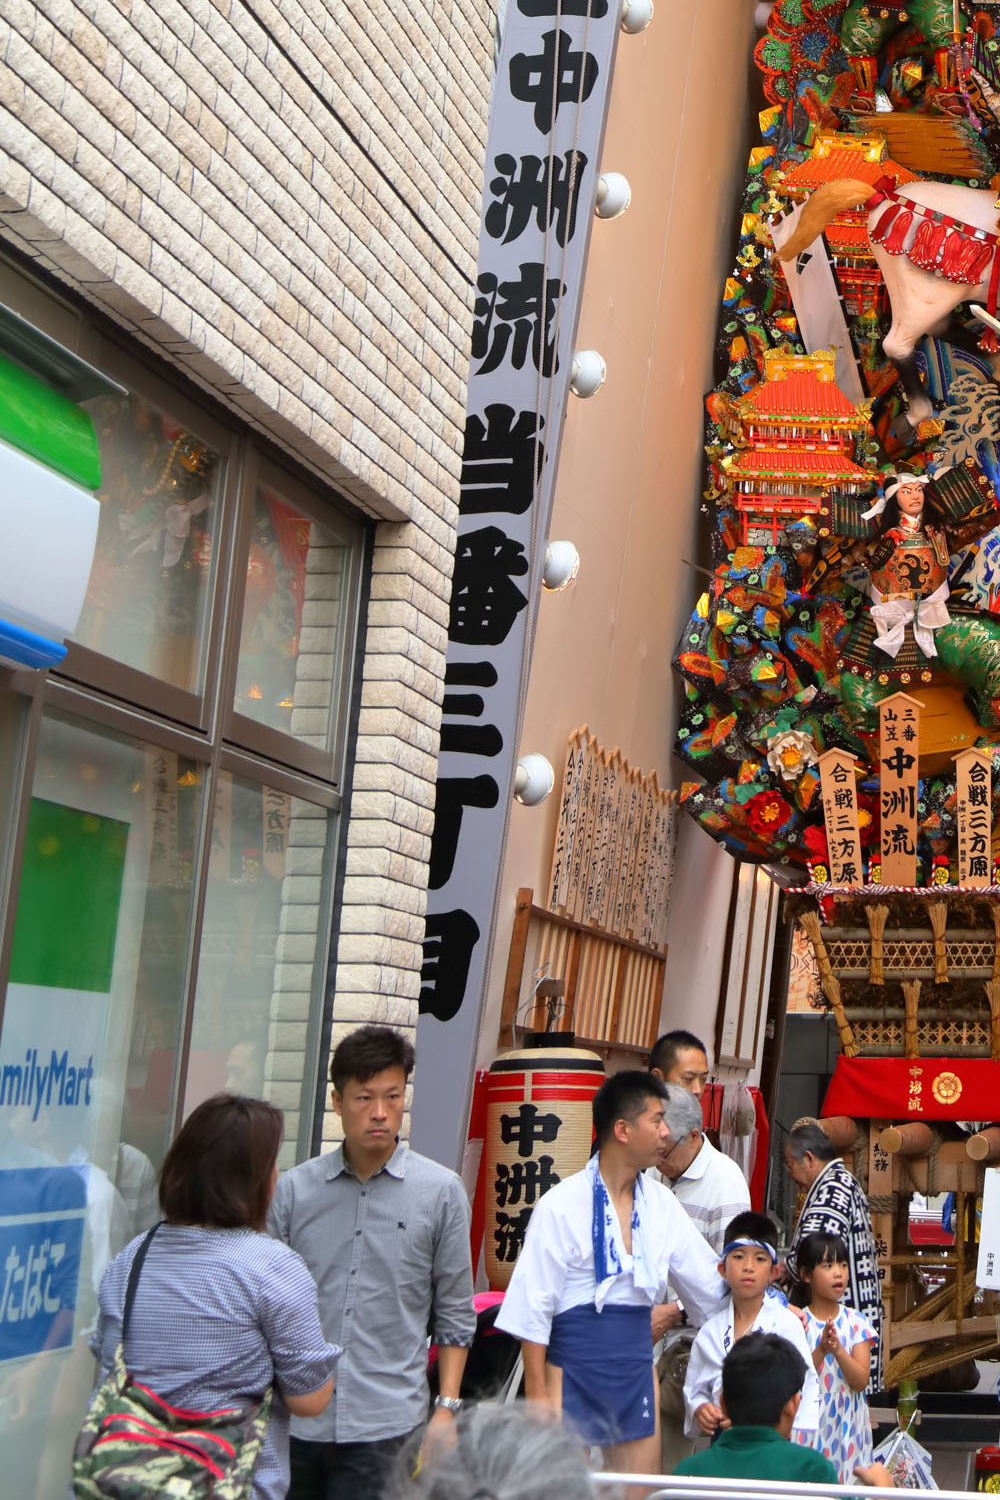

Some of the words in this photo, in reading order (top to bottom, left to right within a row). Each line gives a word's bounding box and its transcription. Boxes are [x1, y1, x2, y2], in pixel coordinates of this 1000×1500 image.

[883, 708, 899, 742] 山笠
[901, 709, 917, 742] 三番
[829, 762, 858, 884] 合戦三方原
[882, 746, 916, 857] 中洲流
[968, 761, 988, 877] 合戦三方原
[0, 1049, 93, 1123] milyMart
[0, 1238, 66, 1324] たばこ
